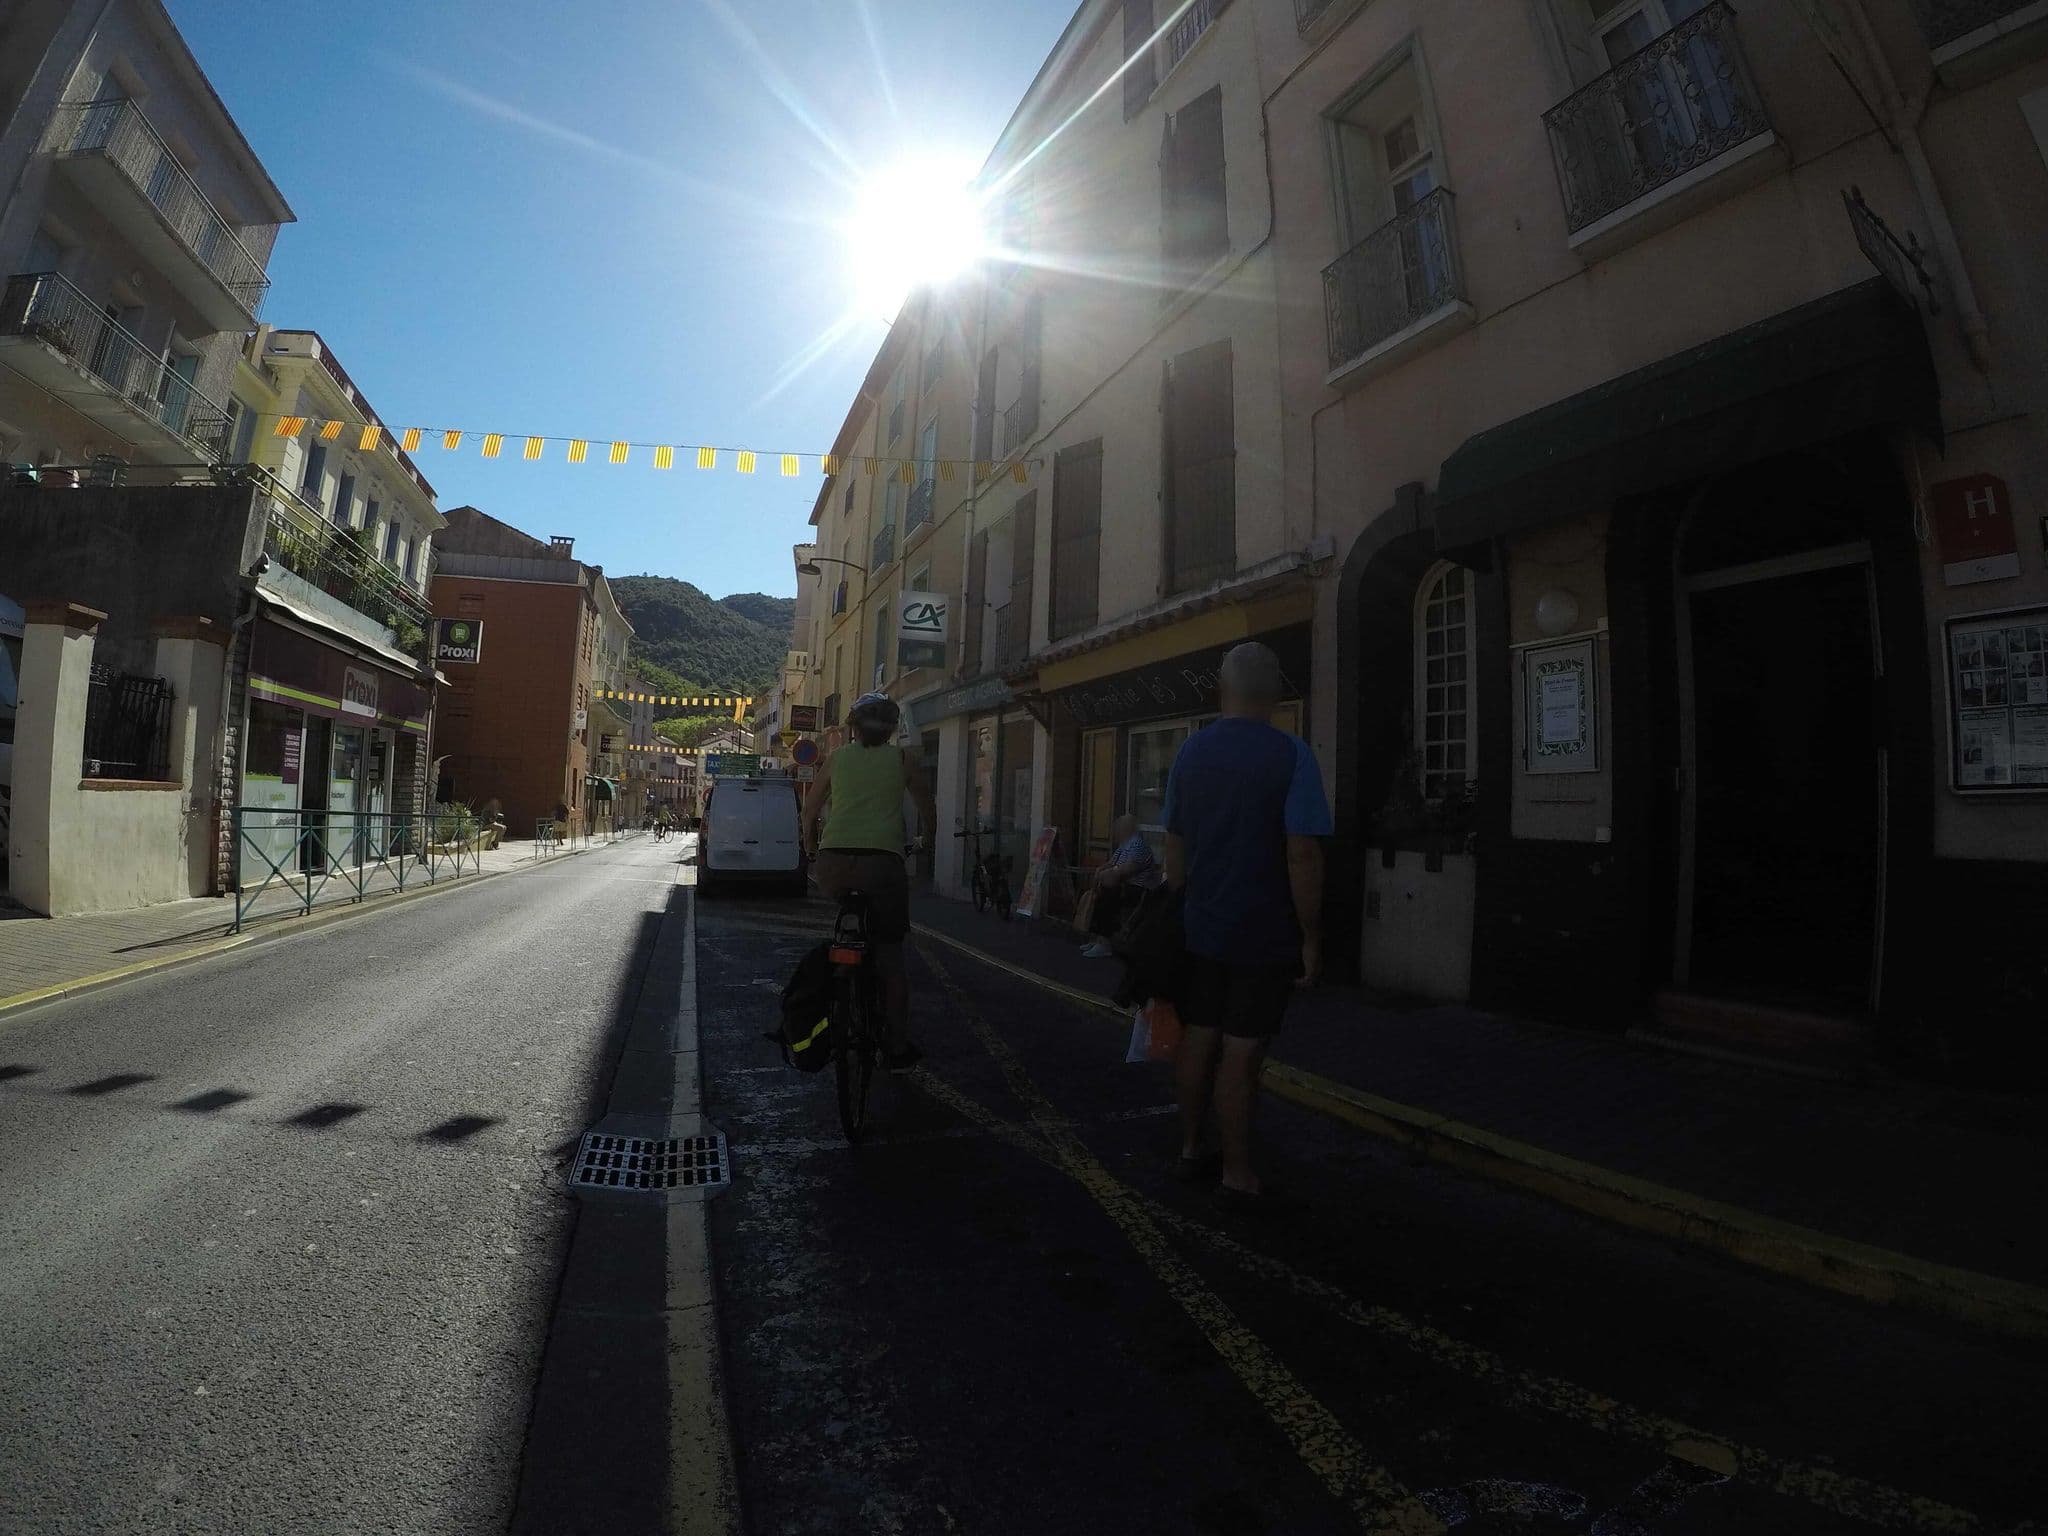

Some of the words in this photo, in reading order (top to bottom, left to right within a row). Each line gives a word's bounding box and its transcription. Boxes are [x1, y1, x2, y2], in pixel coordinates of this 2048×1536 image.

[1964, 485, 1997, 519] H
[903, 603, 945, 626] CA
[440, 644, 474, 658] Proxi
[344, 671, 377, 708] Proxi
